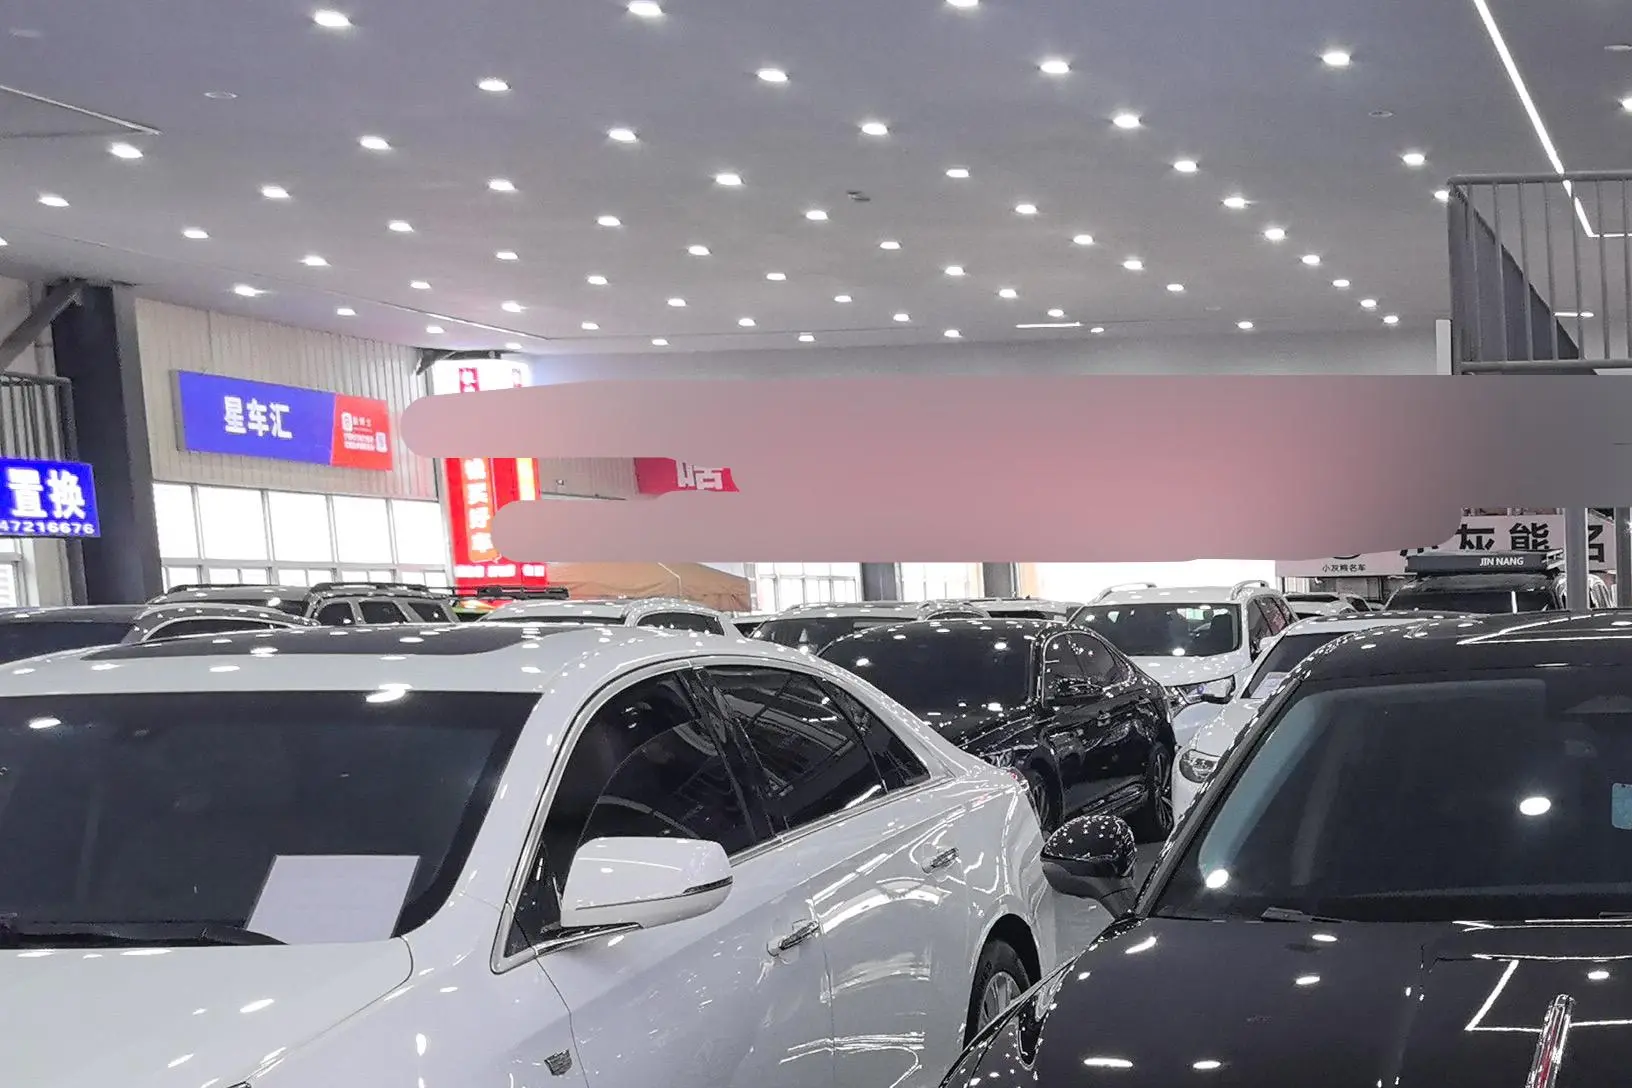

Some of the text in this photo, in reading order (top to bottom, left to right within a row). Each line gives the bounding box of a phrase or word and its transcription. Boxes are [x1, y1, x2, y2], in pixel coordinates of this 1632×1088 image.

[224, 395, 293, 439] 星车汇
[7, 467, 86, 519] 置换
[1480, 556, 1524, 567] JIN NANG
